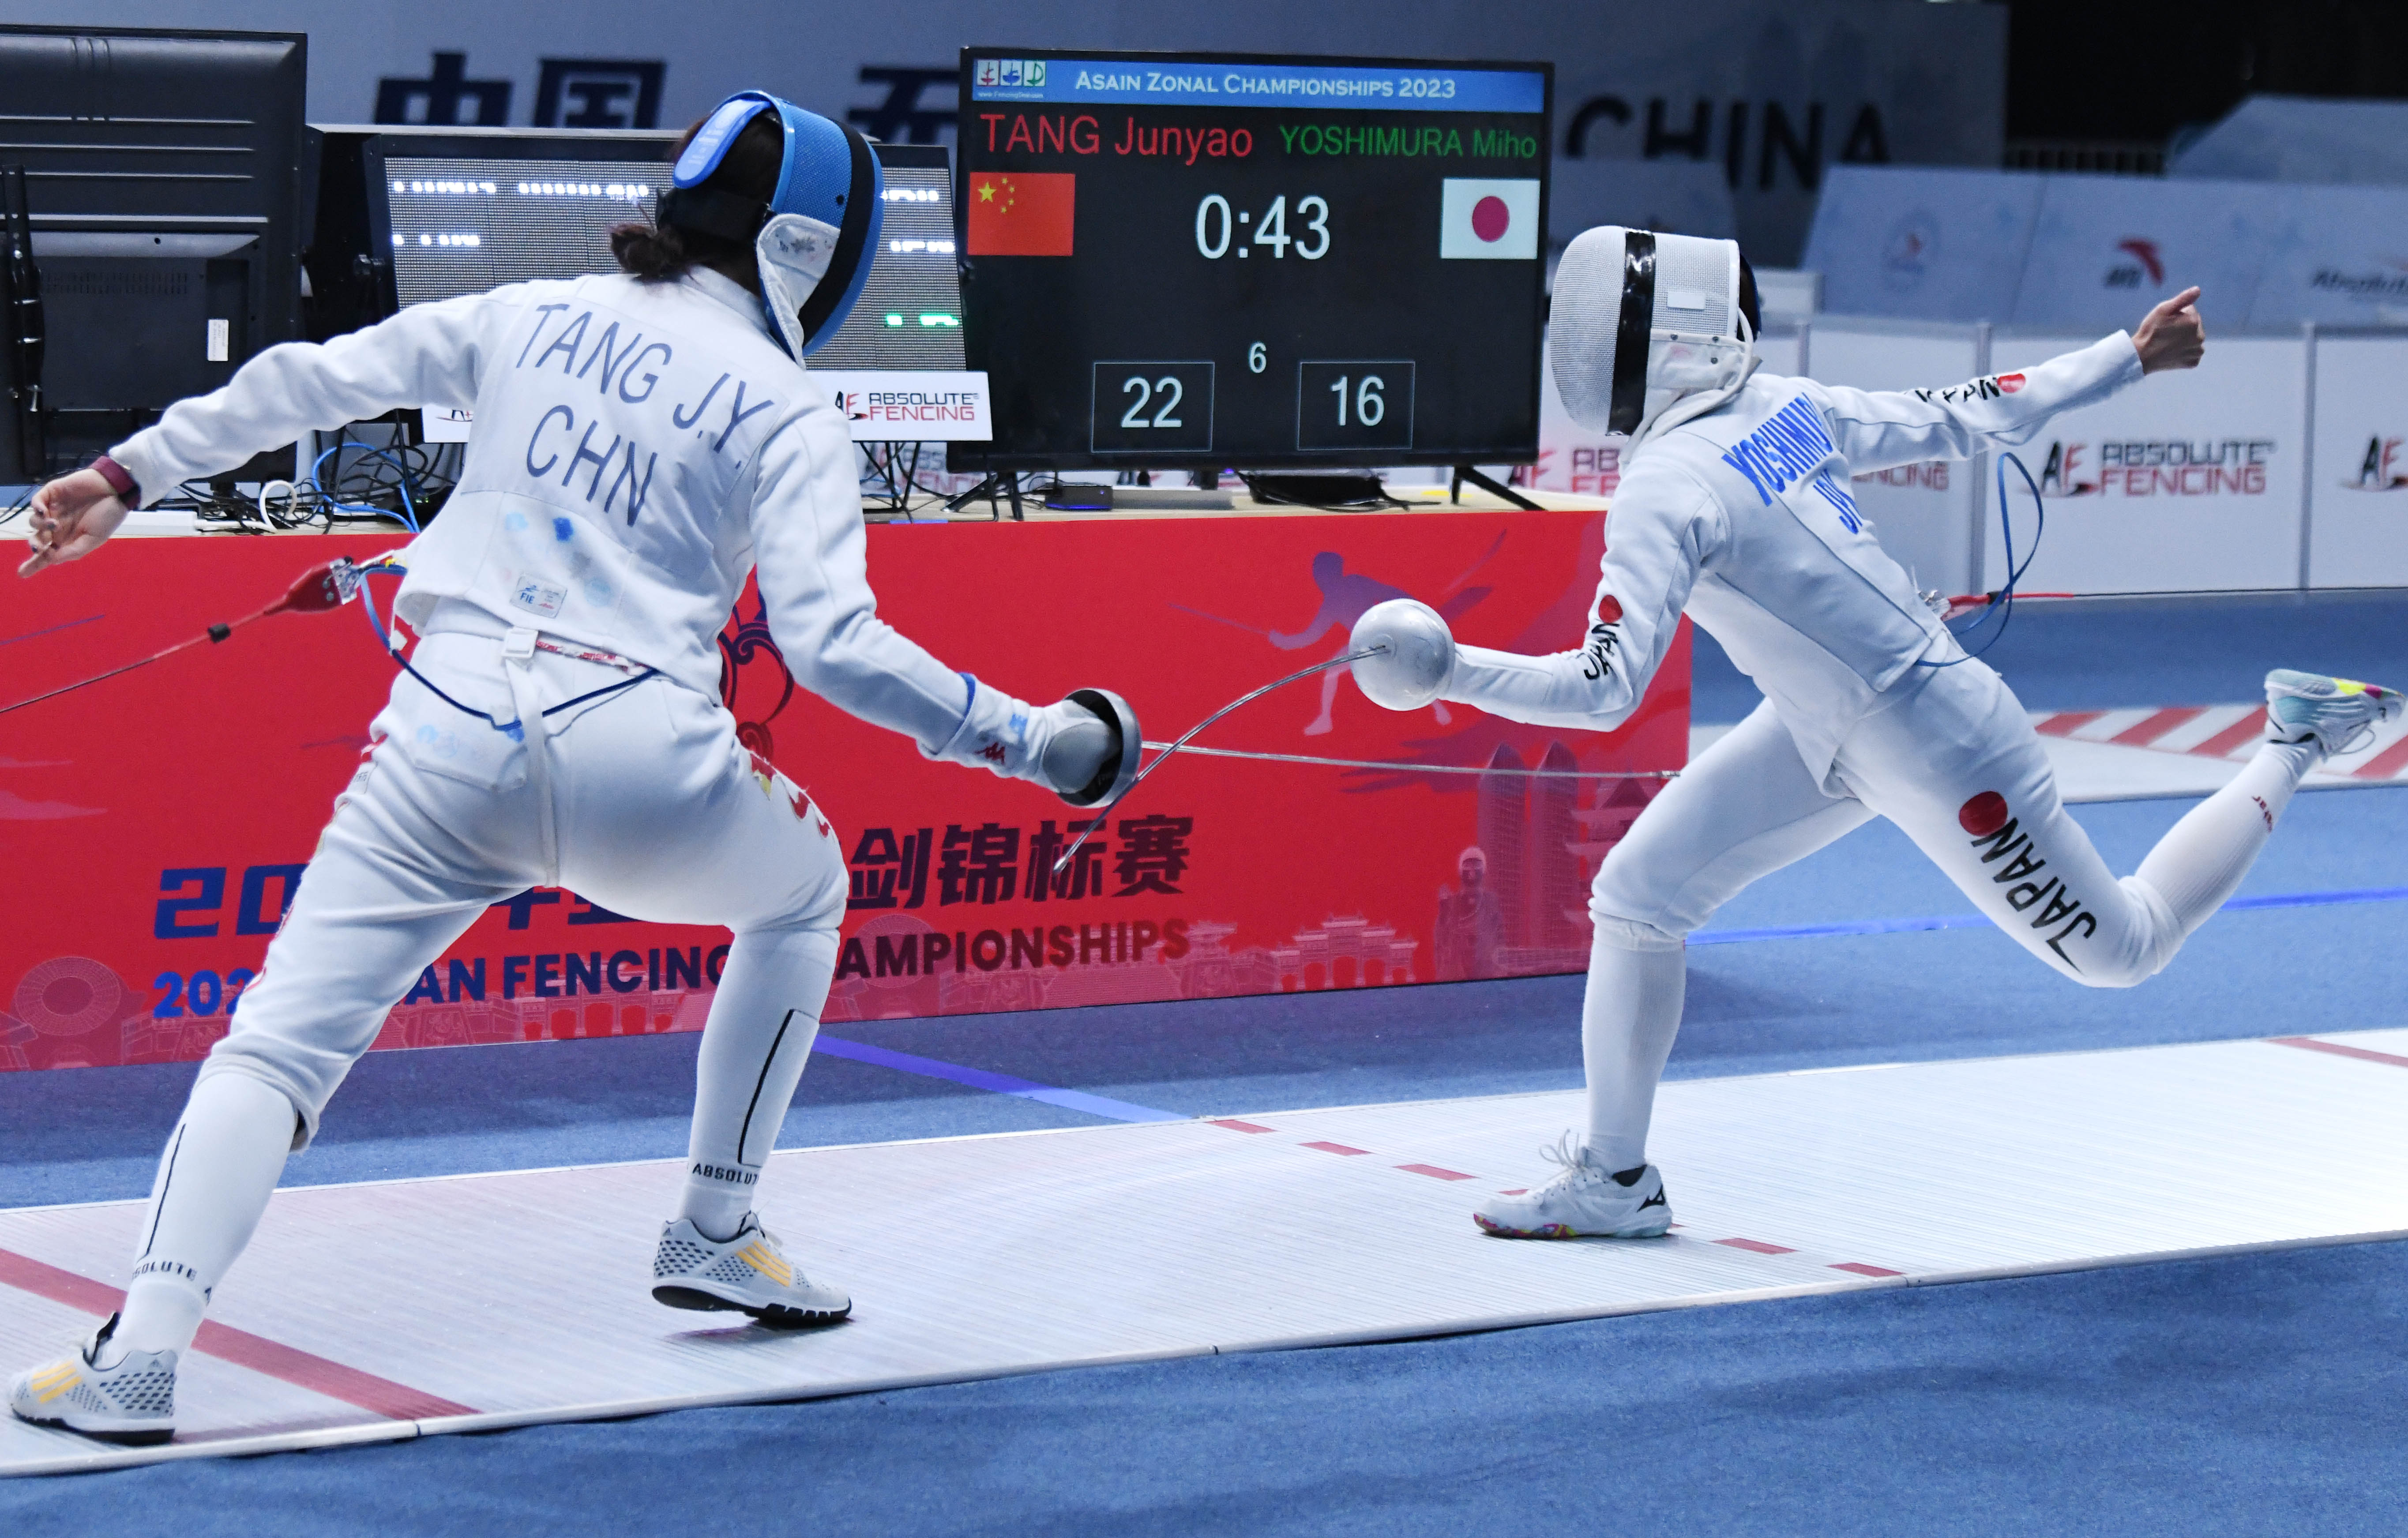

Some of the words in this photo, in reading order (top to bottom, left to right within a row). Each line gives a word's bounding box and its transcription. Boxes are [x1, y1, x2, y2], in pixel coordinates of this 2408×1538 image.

[1398, 78, 1456, 98] 2023
[980, 113, 1100, 155] TANG
[1115, 117, 1252, 165] Junyao
[1280, 124, 1463, 158] YOSHIMURA
[1473, 129, 1537, 159] Miho
[1195, 194, 1330, 259] 0:43
[516, 303, 672, 403] TANG
[1248, 342, 1267, 374] 6
[869, 392, 974, 406] ABSOLUTE
[869, 406, 975, 421] FENCING
[1121, 376, 1183, 428] 22
[1330, 375, 1385, 427] 16
[527, 404, 658, 527] CHN
[2102, 440, 2268, 467] ABSOLUTE
[2100, 466, 2267, 497] FENCING
[847, 814, 1194, 910] 剑锦标赛
[1971, 817, 2097, 974] JAPAN
[835, 918, 1190, 980] AMPIONSHIPS
